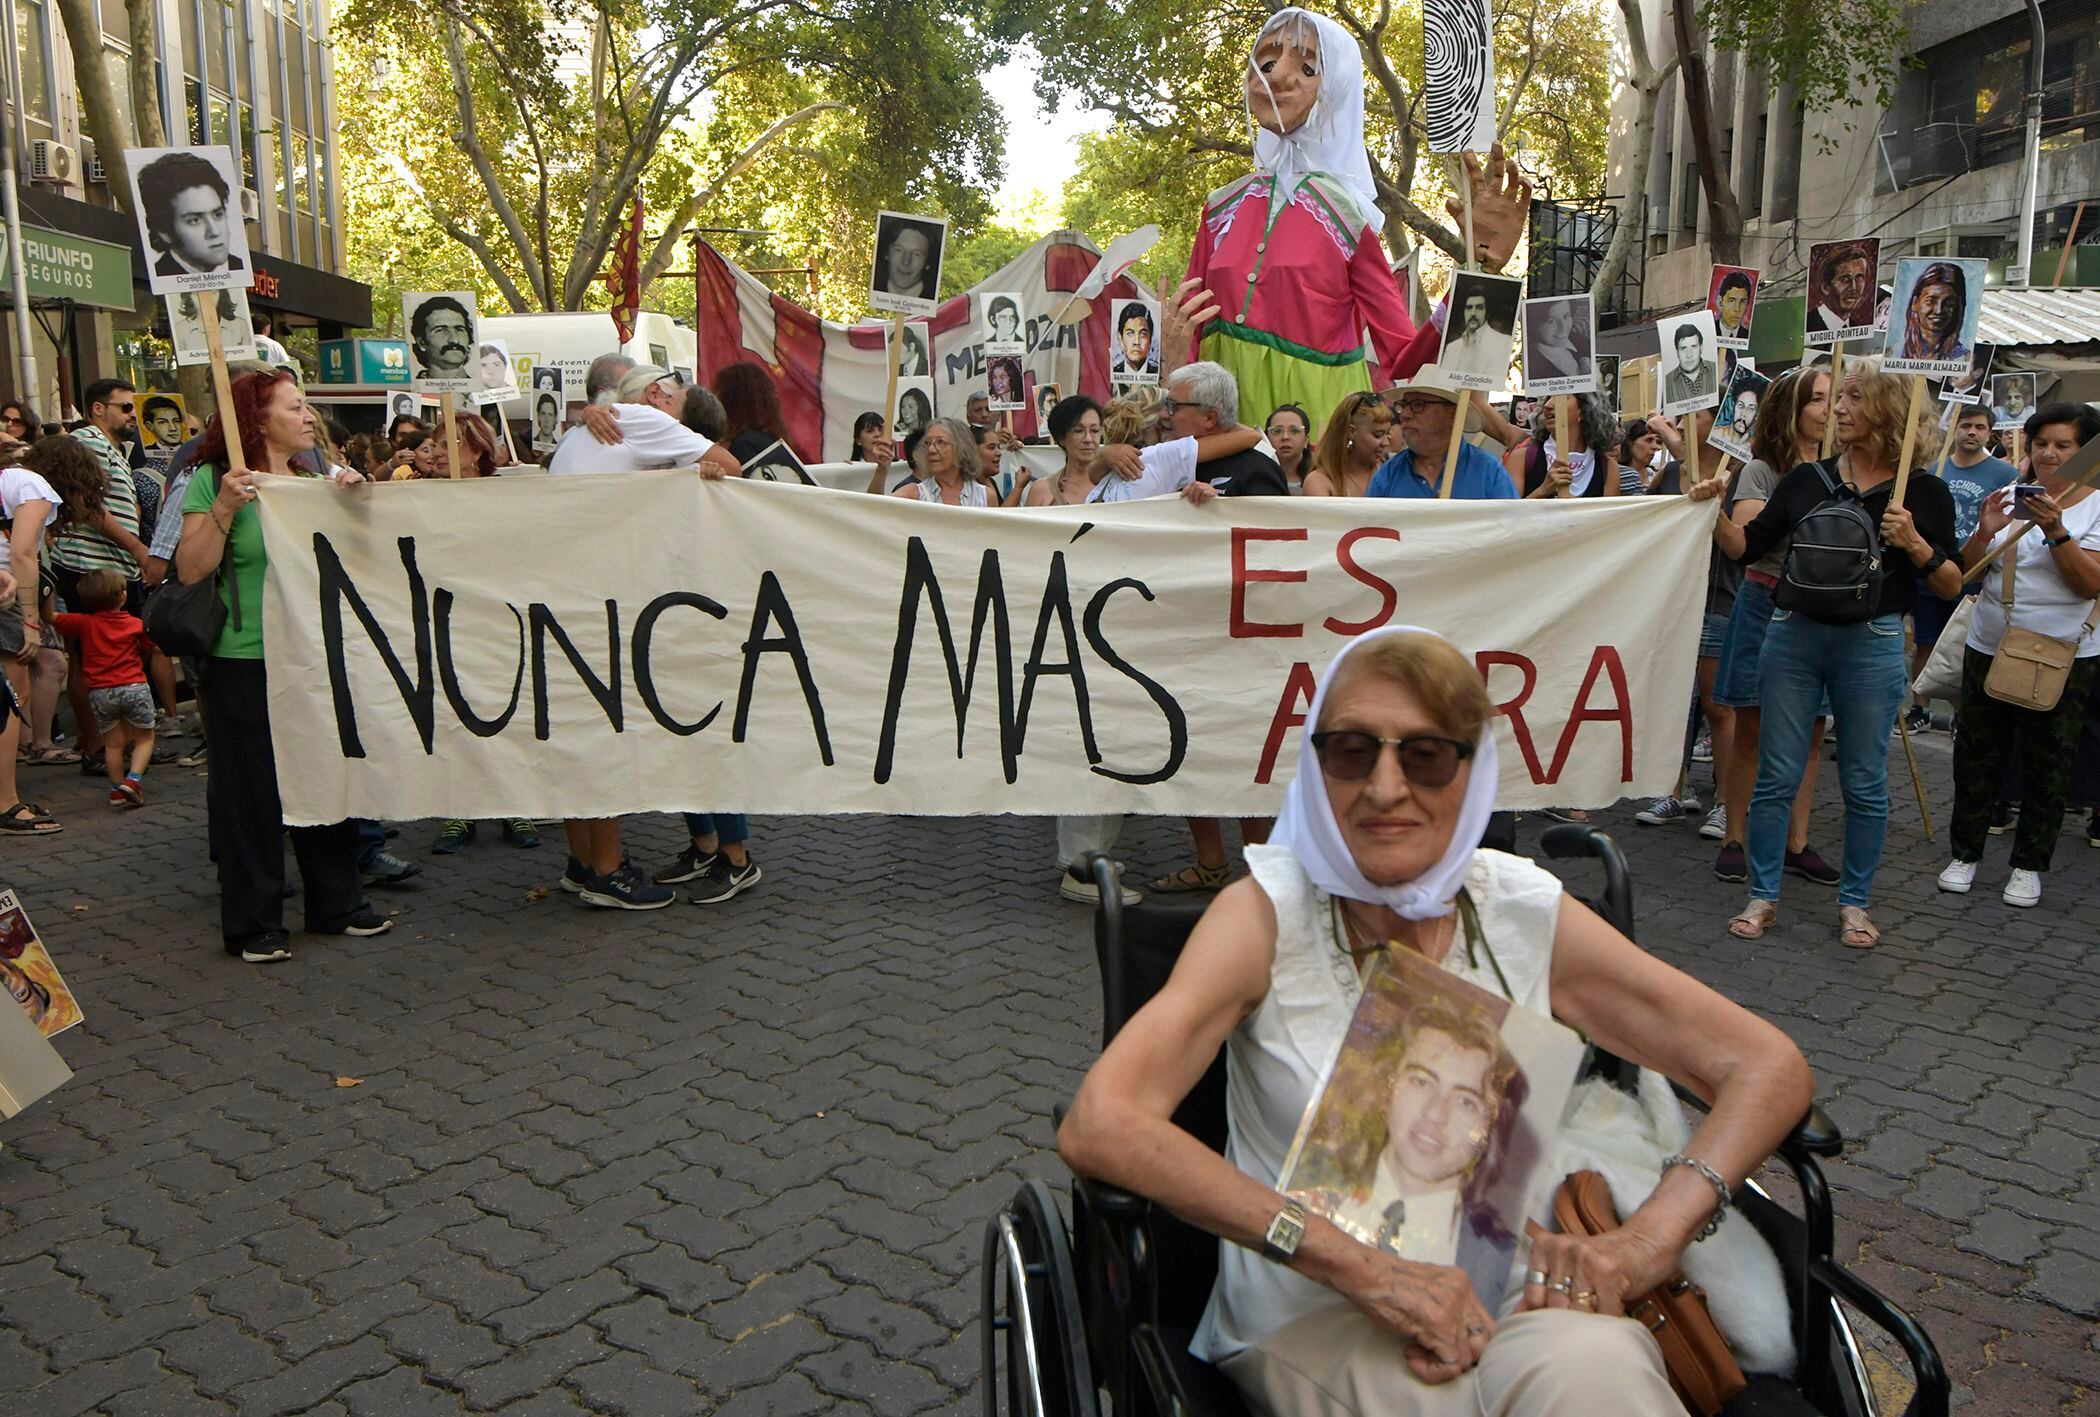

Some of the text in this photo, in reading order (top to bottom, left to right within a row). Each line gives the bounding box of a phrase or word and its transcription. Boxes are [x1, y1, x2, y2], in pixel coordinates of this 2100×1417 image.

[20, 239, 93, 271] TRIUNFO
[23, 261, 92, 289] SEGUROS
[1810, 327, 1869, 342] MIGUEL POINTEAU
[1884, 360, 1967, 372] MARIA MARIN ALMAZAN
[1949, 480, 1985, 498] SCHOOL
[1229, 527, 1400, 638] ES
[313, 522, 1188, 784] NUNCA MÁS
[1254, 645, 1633, 784] ARA
